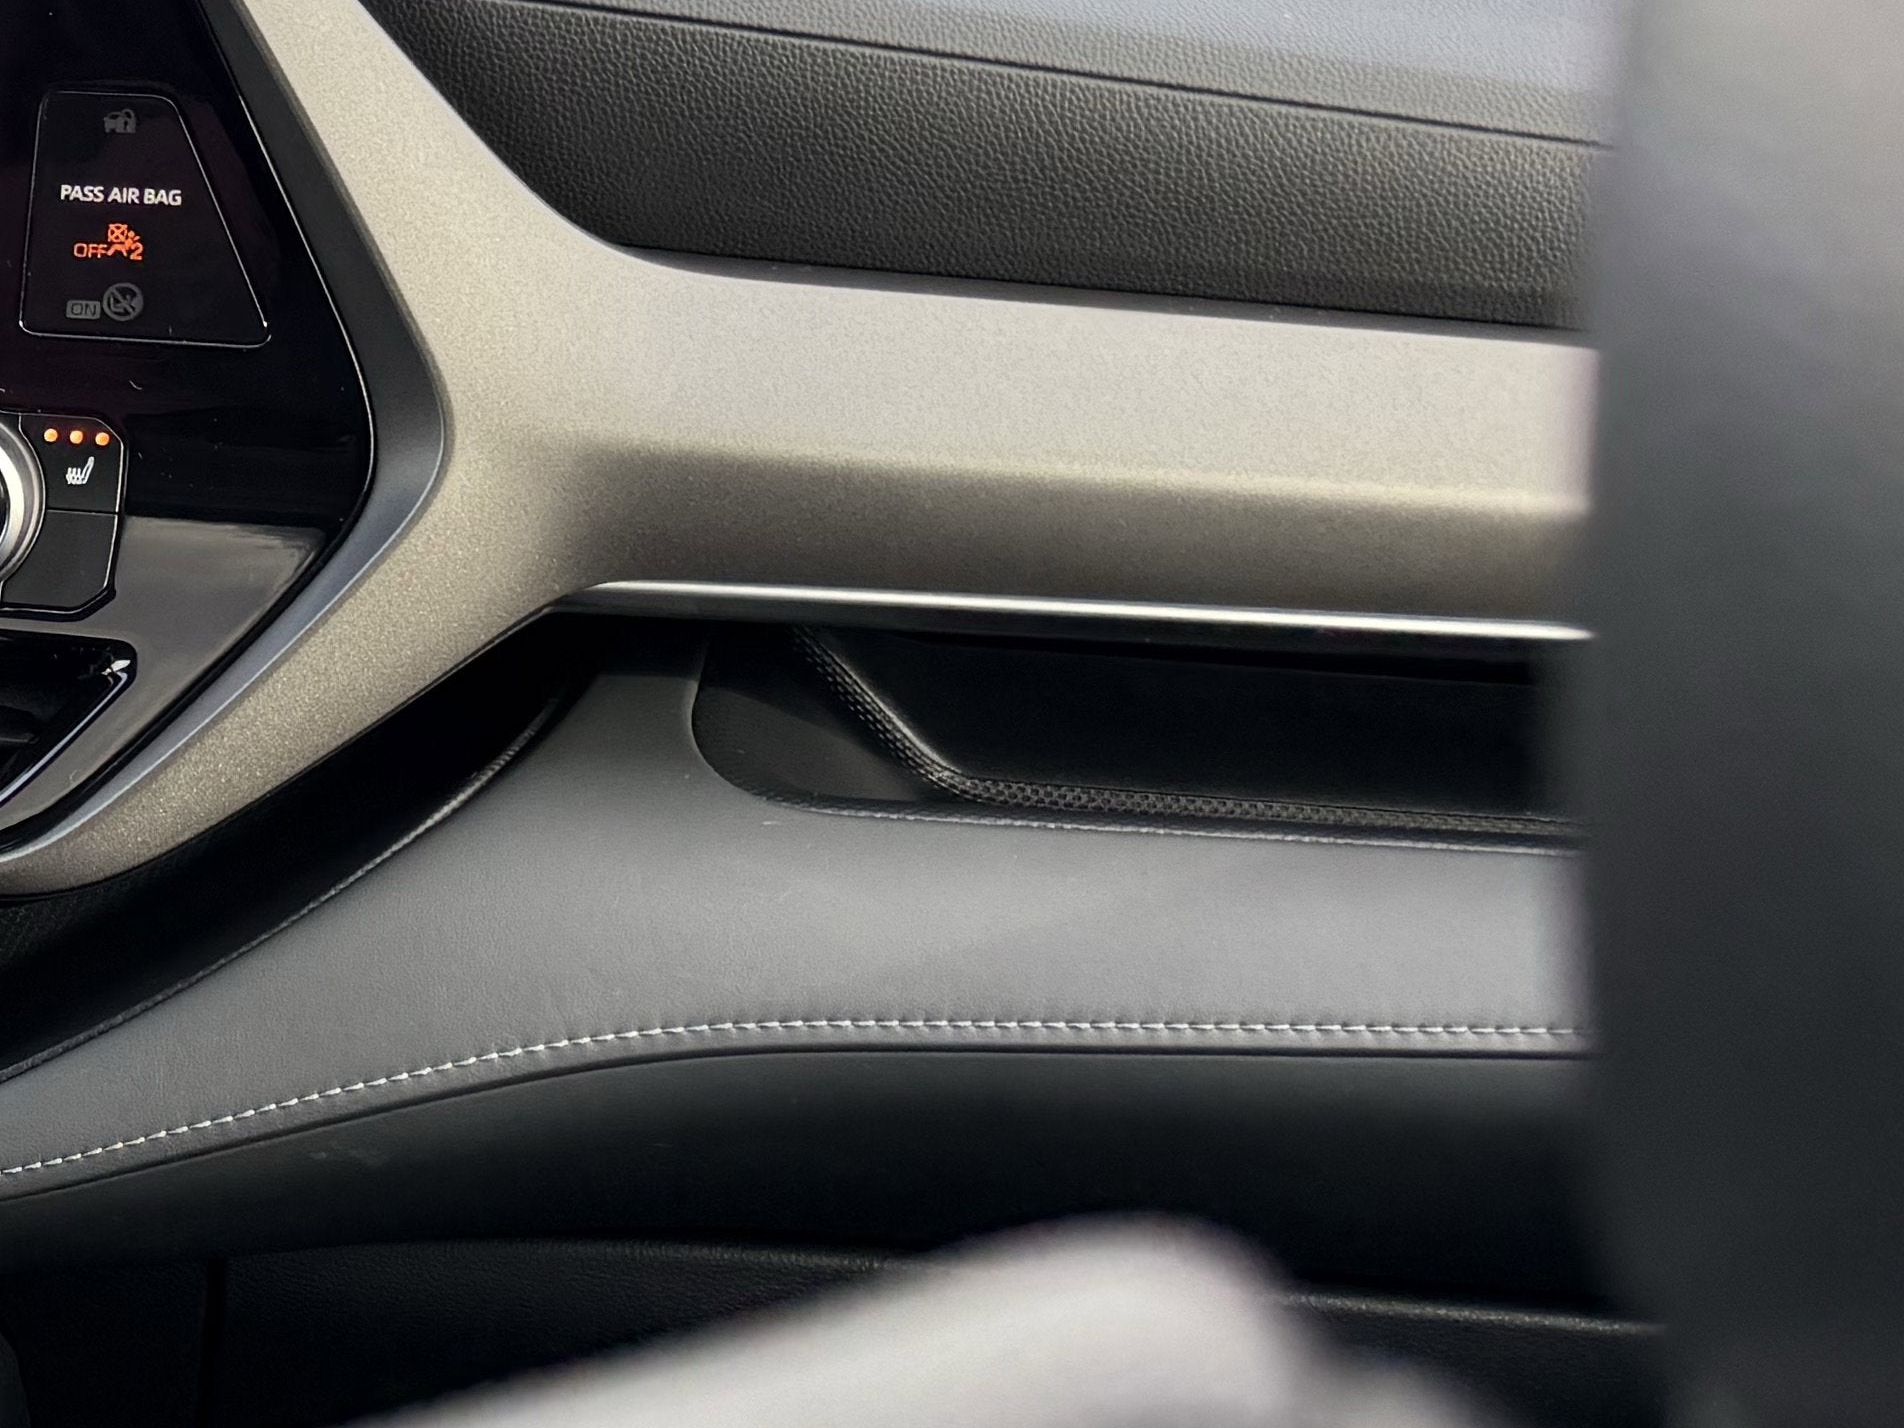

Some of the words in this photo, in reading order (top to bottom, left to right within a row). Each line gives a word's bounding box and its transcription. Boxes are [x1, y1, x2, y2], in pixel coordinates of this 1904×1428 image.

[60, 184, 105, 202] PASS
[107, 187, 140, 204] AIR
[143, 188, 182, 206] BAG
[73, 243, 107, 258] OFF
[71, 302, 97, 316] ON
